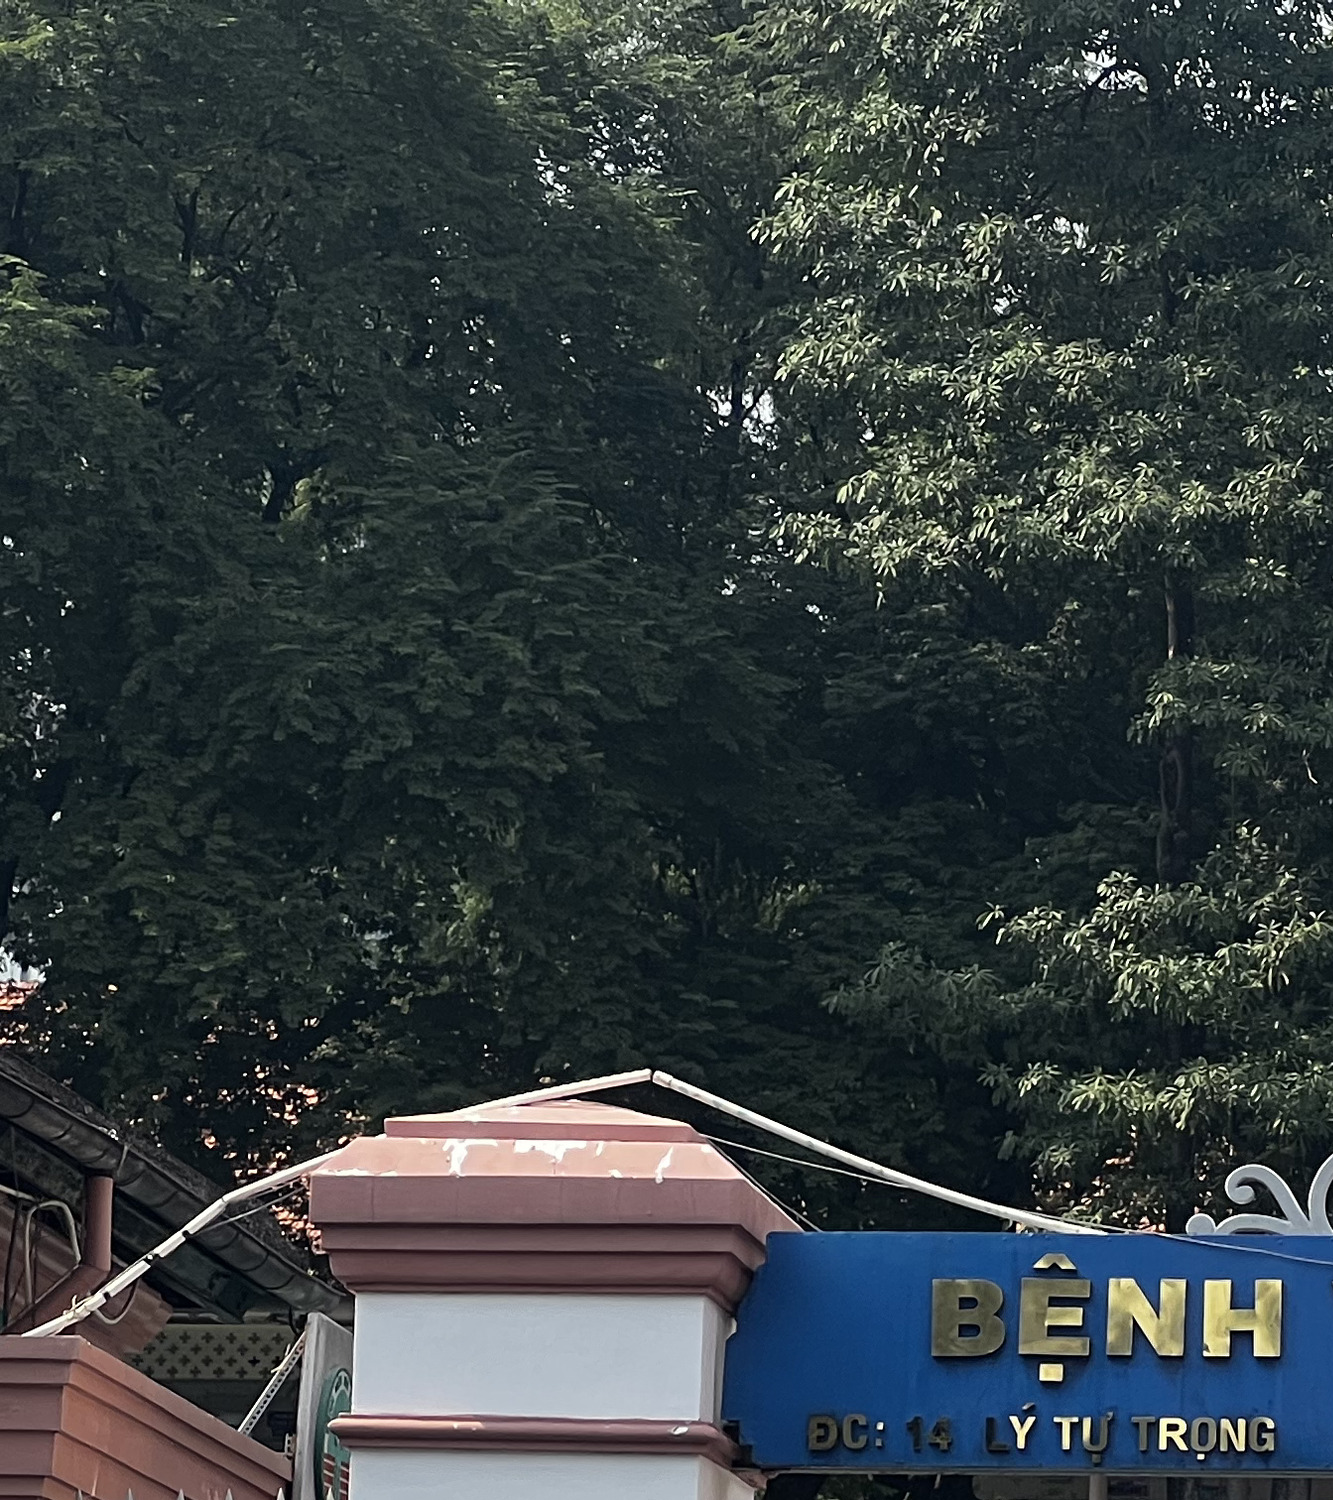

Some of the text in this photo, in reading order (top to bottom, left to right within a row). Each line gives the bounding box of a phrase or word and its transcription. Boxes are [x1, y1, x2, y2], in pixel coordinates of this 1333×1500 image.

[931, 1252, 1283, 1384] BỆNH
[807, 1413, 885, 1452] ĐC:
[985, 1402, 1036, 1452] LÝ
[1053, 1411, 1114, 1464] TỰ
[1131, 1416, 1276, 1461] TRỌNG
